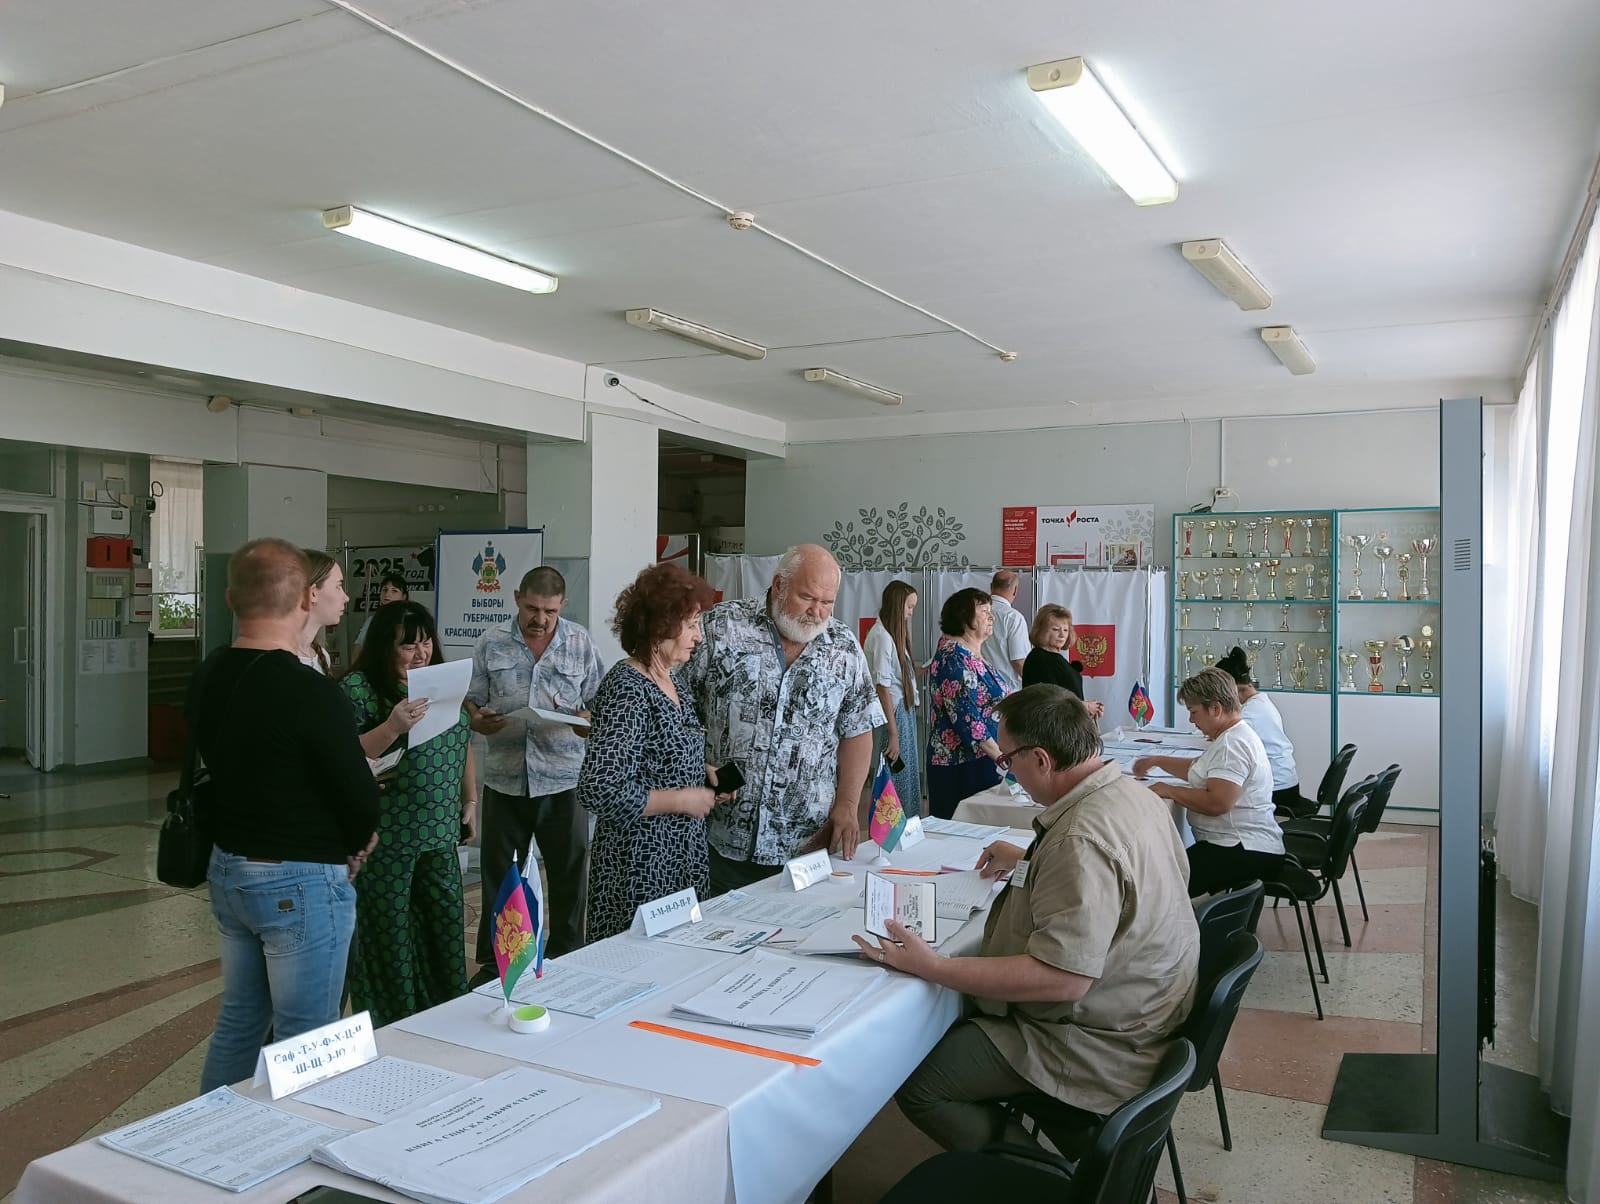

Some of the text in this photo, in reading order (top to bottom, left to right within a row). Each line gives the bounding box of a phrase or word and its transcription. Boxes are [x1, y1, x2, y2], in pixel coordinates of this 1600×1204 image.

[1041, 517, 1065, 525] ТОЧКА
[352, 557, 405, 577] 2025
[471, 598, 504, 608] ВЫБОРЫ
